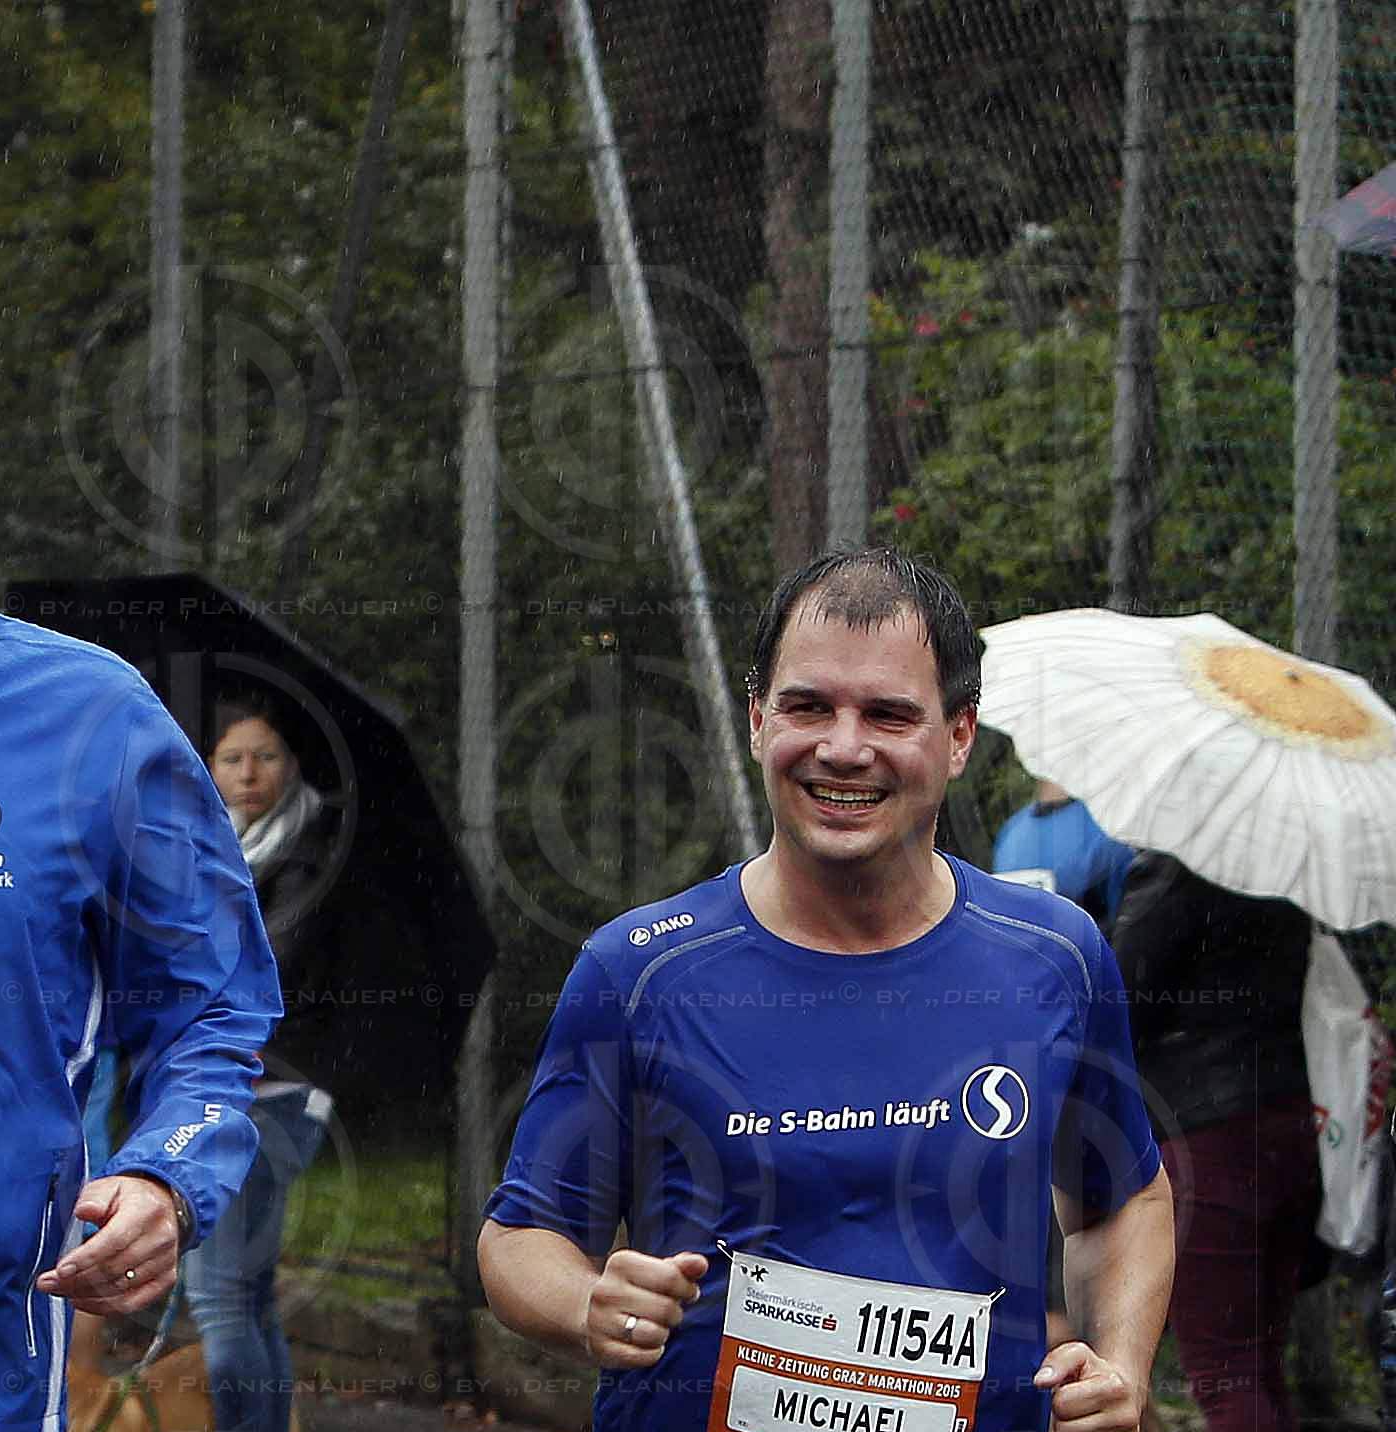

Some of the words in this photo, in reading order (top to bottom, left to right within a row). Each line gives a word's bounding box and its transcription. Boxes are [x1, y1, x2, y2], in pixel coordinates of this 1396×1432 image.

[651, 913, 694, 936] JAKO
[726, 1113, 771, 1136] Die
[780, 1106, 875, 1133] S-Bahn
[885, 1099, 950, 1128] läuft
[746, 1286, 824, 1314] Steiermärkische
[744, 1299, 822, 1329] SPARKASSE
[856, 1302, 977, 1369] 11154A
[737, 1345, 776, 1369] KLEINE
[777, 1354, 830, 1380] ZEITUNG
[832, 1368, 865, 1386] GRAZ
[867, 1375, 934, 1396] MARATHON
[934, 1383, 961, 1399] 2015
